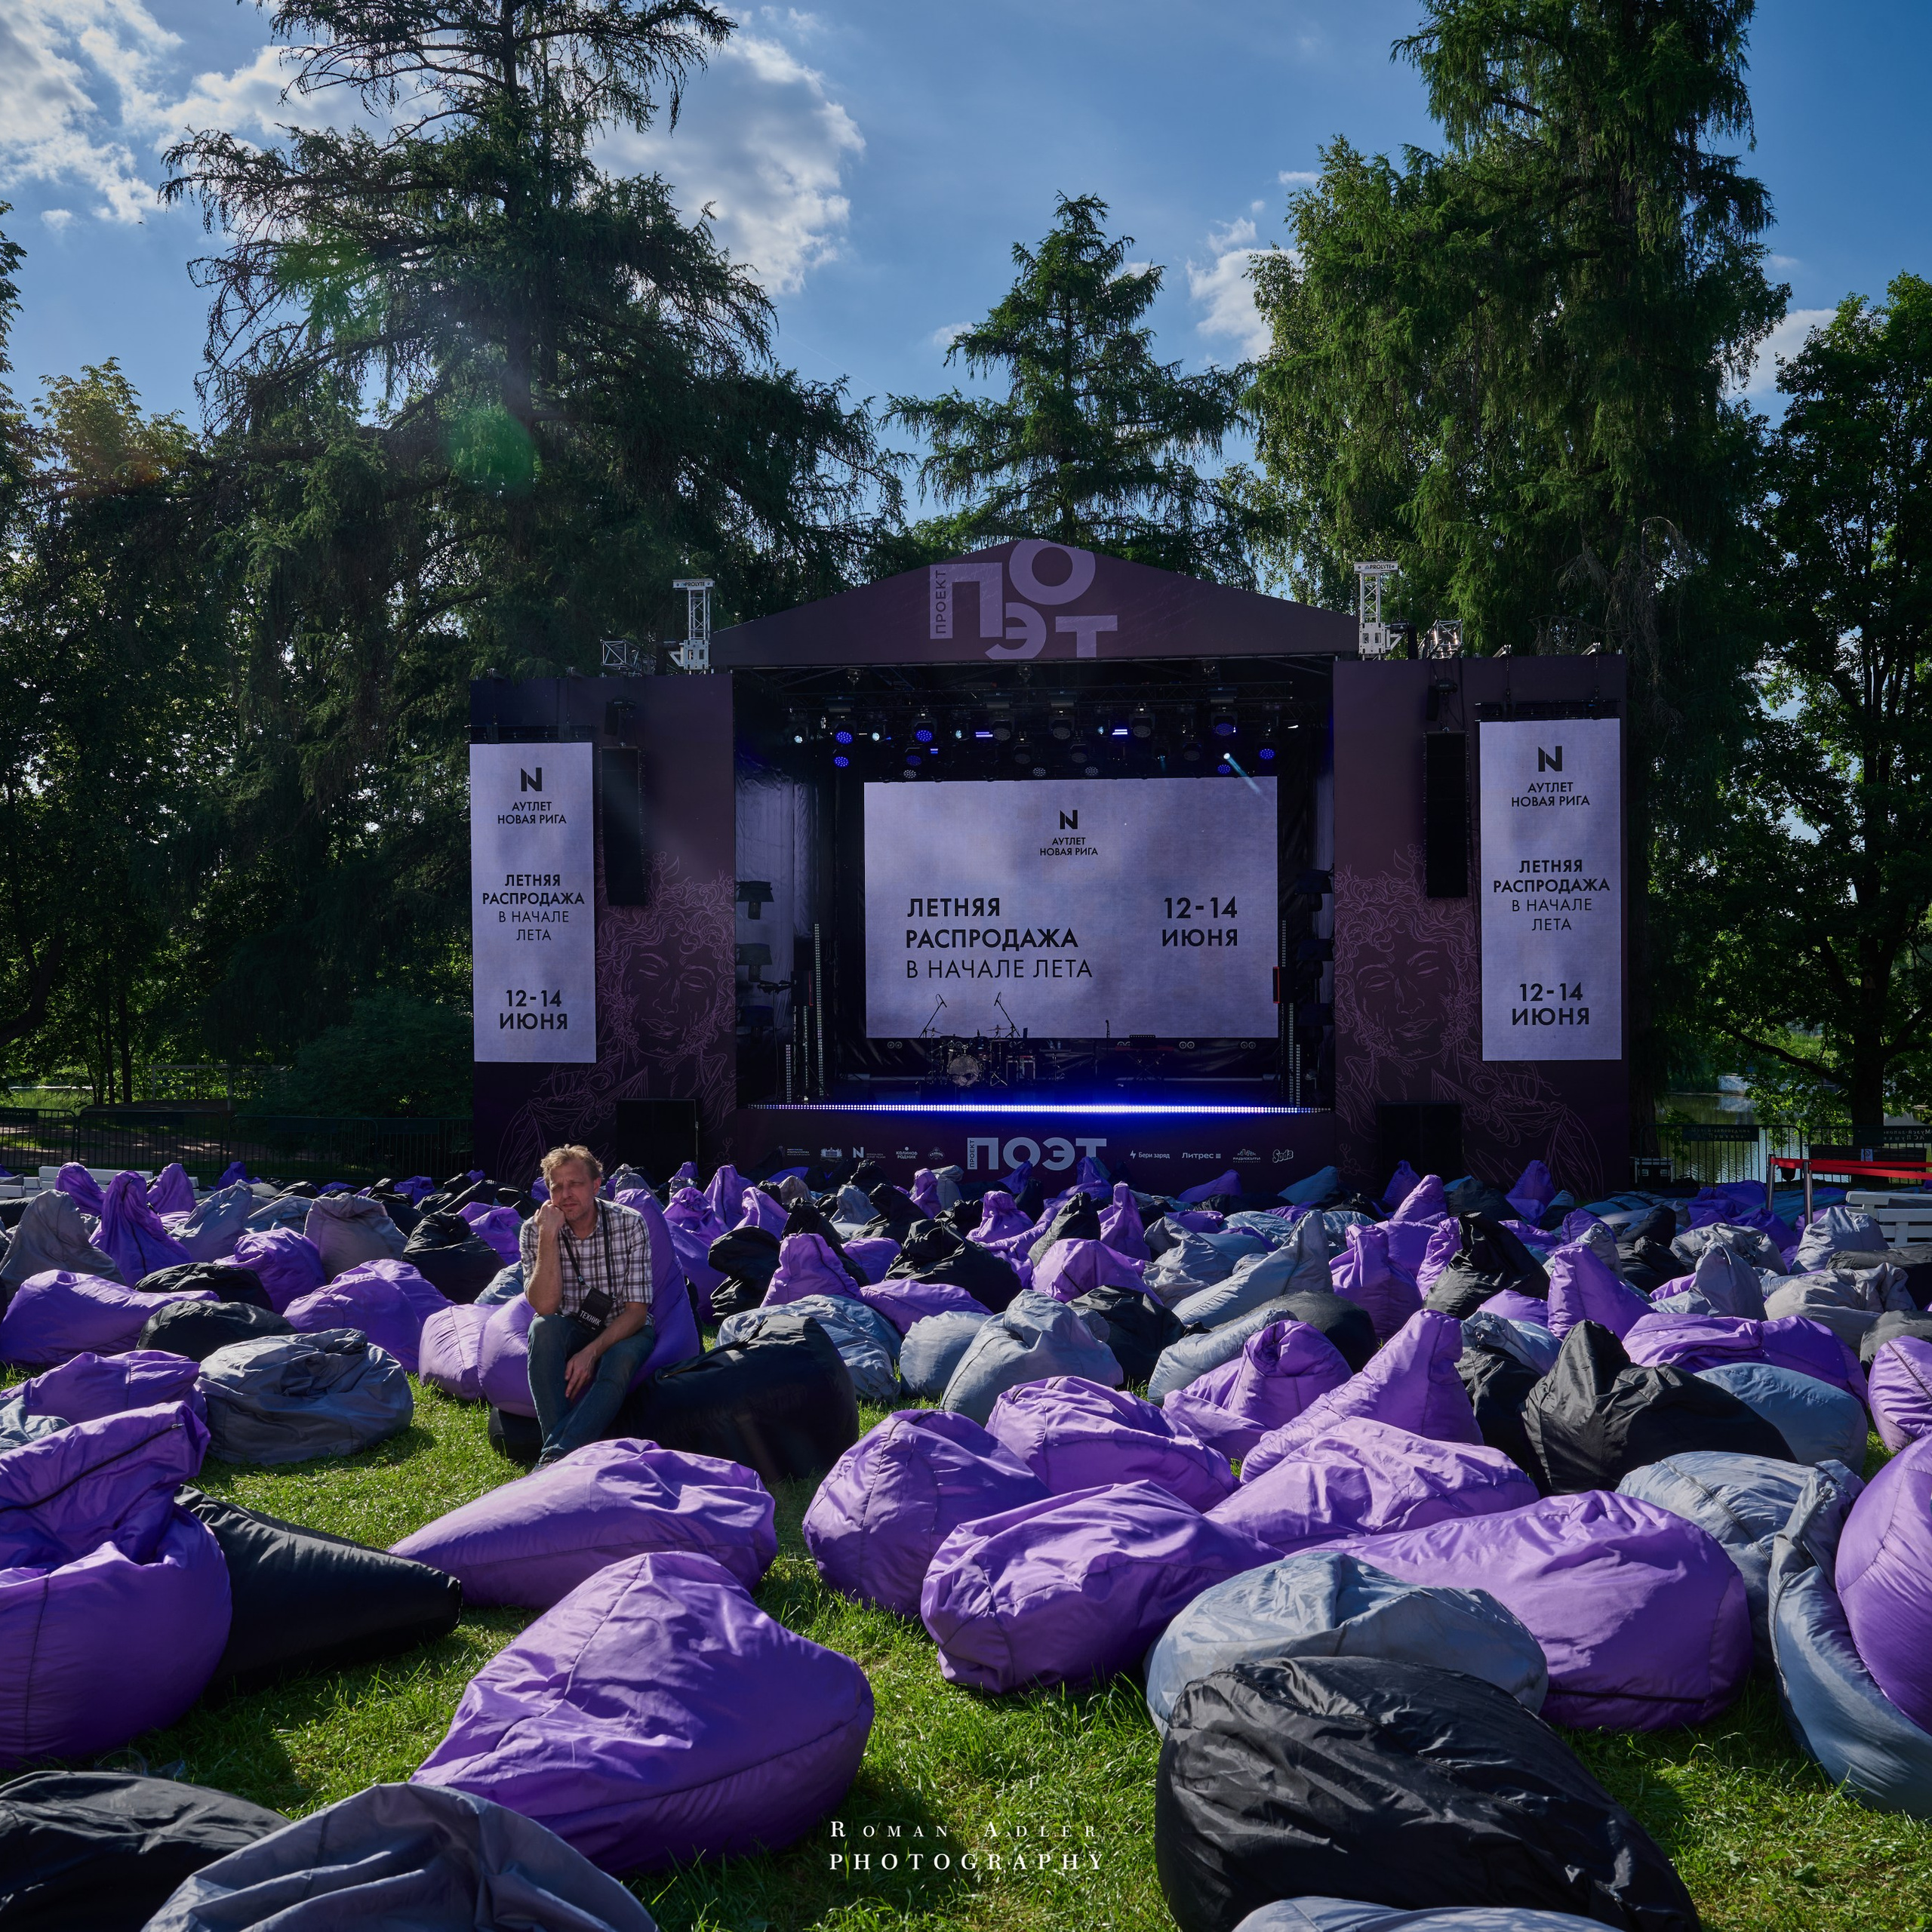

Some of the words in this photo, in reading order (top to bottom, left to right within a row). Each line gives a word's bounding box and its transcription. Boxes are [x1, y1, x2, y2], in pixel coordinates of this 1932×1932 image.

[935, 570, 946, 634] ПРОЕКТ
[1538, 746, 1562, 772] N
[521, 768, 542, 792] N
[1527, 782, 1574, 792] АУТЛЕТ
[512, 801, 552, 811] АУТЛЕТ
[1512, 796, 1555, 807] НОВАЯ
[1560, 795, 1590, 805] РИГА
[498, 814, 535, 824] НОВАЯ
[540, 814, 567, 823] РИГА
[1060, 810, 1078, 829] N
[1519, 860, 1582, 872] ЛЕТНЯЯ
[505, 875, 560, 886] ЛЕТНЯЯ
[1494, 878, 1611, 894] РАСПРОДАЖА
[483, 892, 585, 906] РАСПРОДАЖА
[1512, 900, 1520, 912] В
[1527, 899, 1592, 911] НАЧАЛЕ
[907, 898, 999, 917] ЛЕТНЯЯ
[1164, 897, 1237, 918] 12-14
[500, 911, 506, 922] В
[512, 911, 568, 922] НАЧАЛЕ
[1532, 918, 1571, 931] ЛЕТА
[516, 929, 551, 940] ЛЕТА
[907, 928, 1078, 952] РАСПРОДАЖА
[1162, 929, 1237, 946] ИЮНЯ
[907, 961, 918, 978] В
[929, 959, 1023, 978] НАЧАЛЕ
[1033, 959, 1093, 977] ЛЕТА
[506, 989, 561, 1007] 12-14
[1520, 981, 1583, 1001] 12-14
[500, 1013, 568, 1029] ИЮНЯ
[1512, 1008, 1589, 1025] ИЮНЯ
[853, 1147, 864, 1158] N
[968, 1137, 1107, 1171] ПОЭТ
[1139, 1151, 1152, 1159] Бери
[1182, 1152, 1214, 1160] Литрес
[1272, 1149, 1294, 1163] Soda
[580, 1310, 601, 1327] ТЕХНИК
